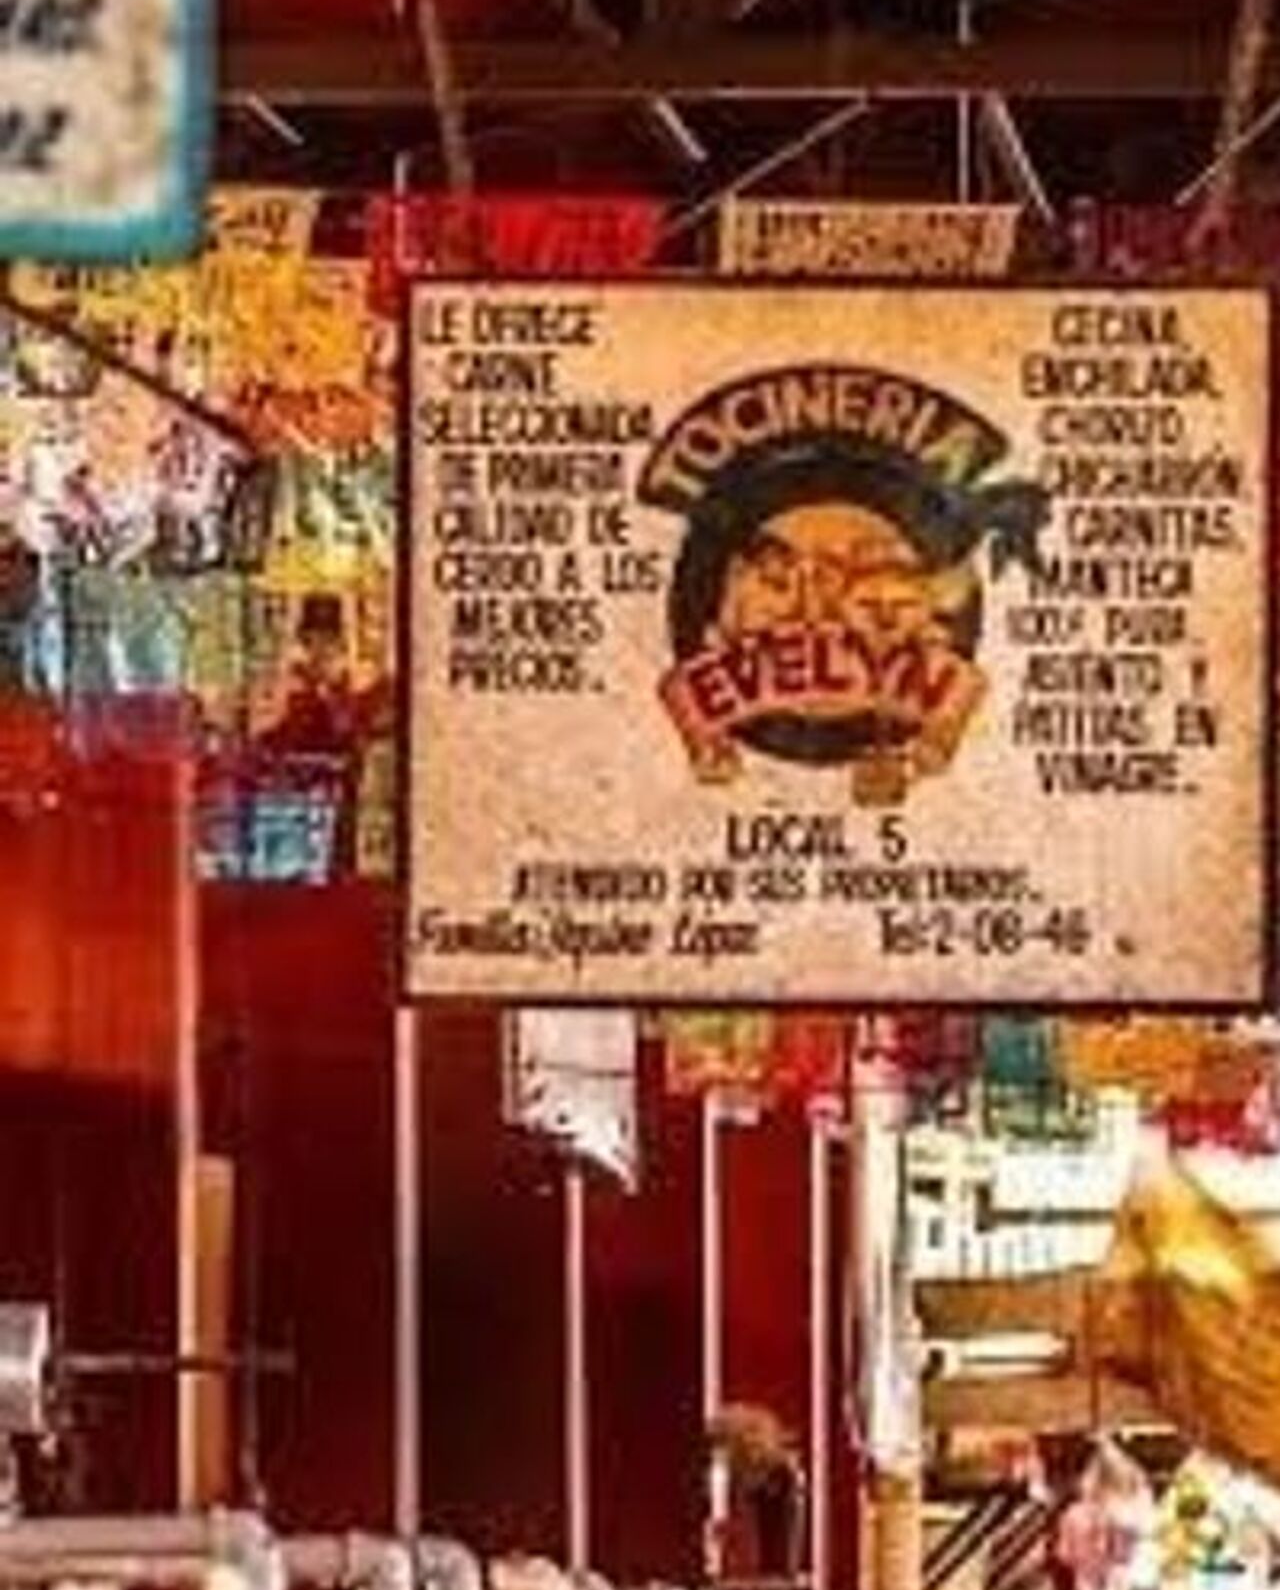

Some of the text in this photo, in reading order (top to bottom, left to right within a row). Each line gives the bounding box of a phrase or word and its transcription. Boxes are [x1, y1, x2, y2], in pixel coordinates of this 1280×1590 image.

[420, 299, 460, 345] LE
[588, 504, 630, 545] DE
[556, 551, 582, 593] A
[603, 551, 664, 593] LOS
[686, 624, 960, 721] EVELYN
[1174, 703, 1217, 749] EN
[726, 815, 908, 863] LOCAL 5
